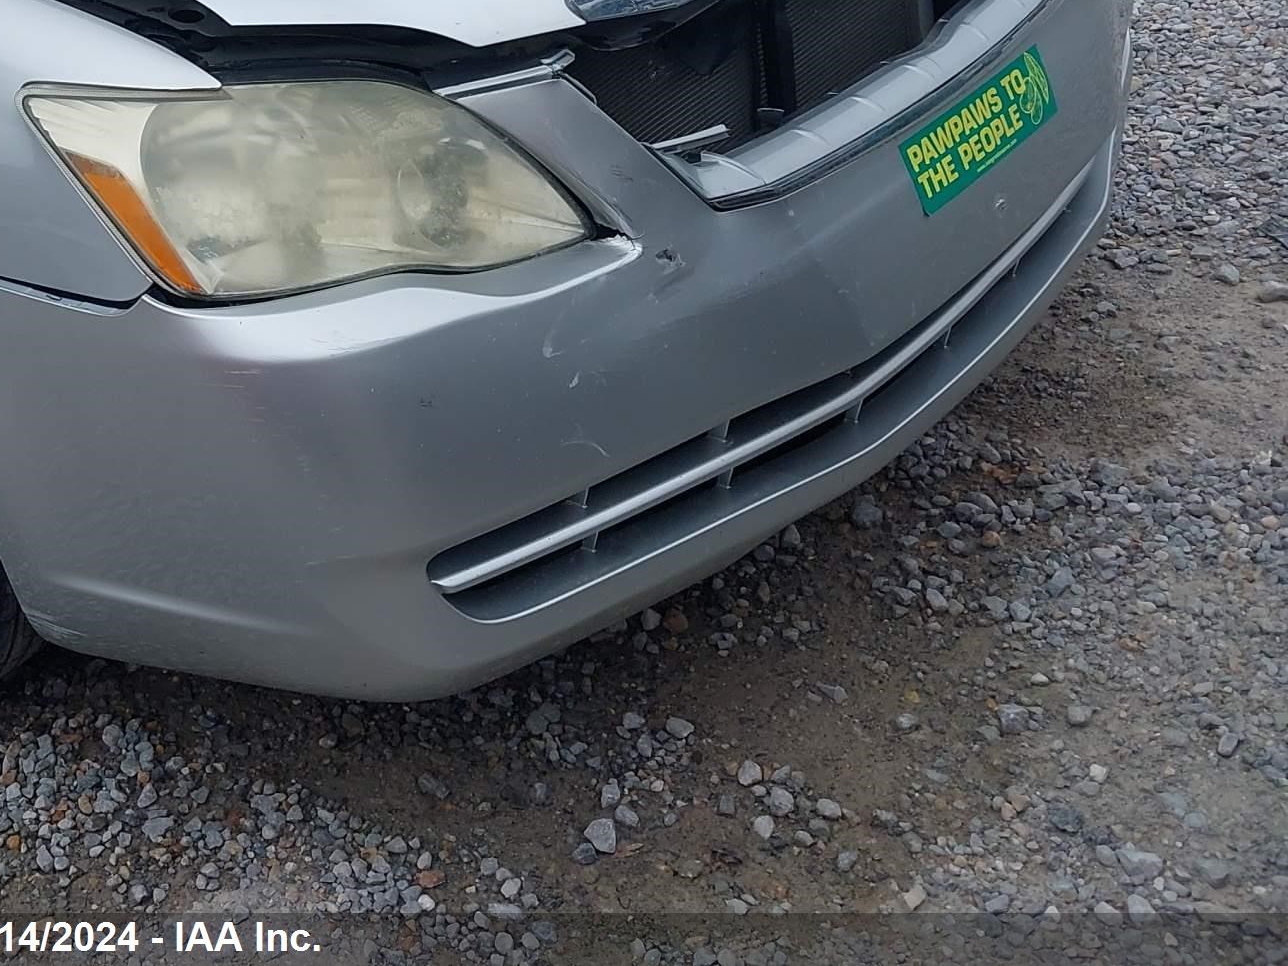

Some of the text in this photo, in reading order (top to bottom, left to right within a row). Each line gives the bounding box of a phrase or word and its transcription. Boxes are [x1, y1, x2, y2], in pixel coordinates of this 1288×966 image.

[907, 87, 1002, 173] PAWPAWS
[1000, 69, 1027, 101] TO
[917, 154, 960, 199] THE
[958, 104, 1024, 170] PEOPLE
